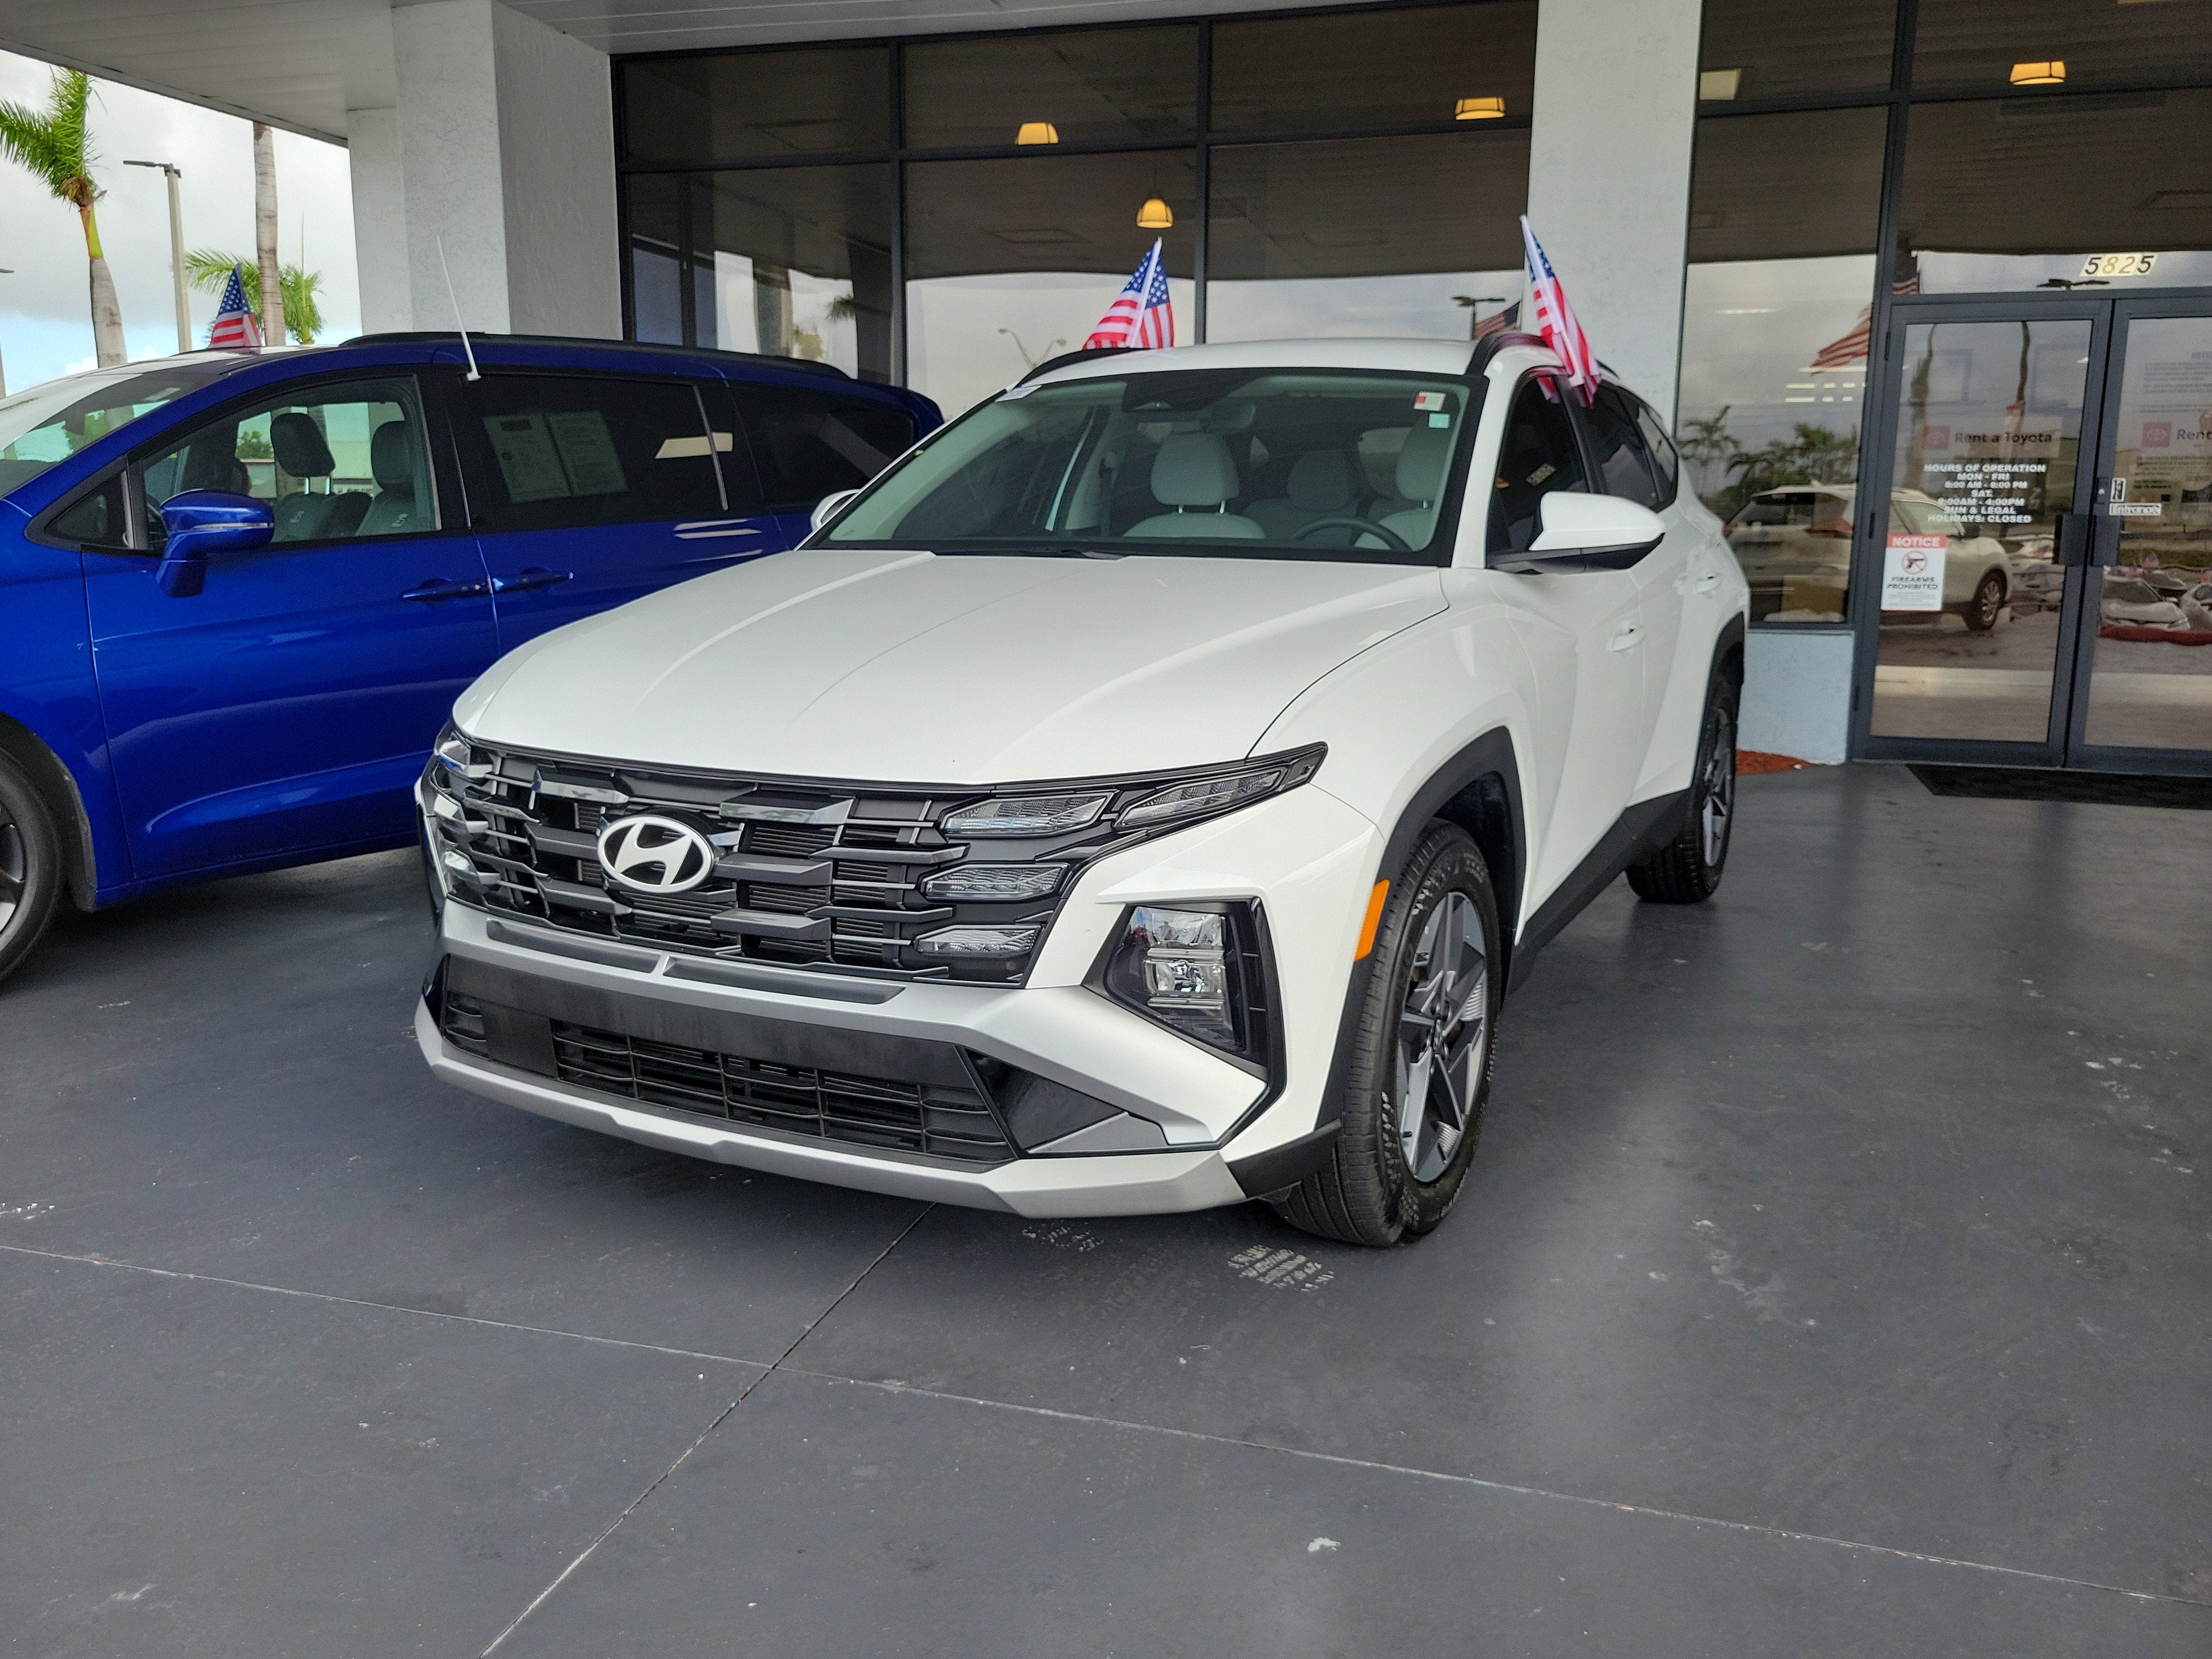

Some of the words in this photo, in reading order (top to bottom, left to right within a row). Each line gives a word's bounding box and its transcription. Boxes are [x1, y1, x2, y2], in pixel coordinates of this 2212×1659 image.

[2085, 256, 2154, 274] 5825
[2177, 428, 2212, 439] Rent
[1955, 432, 1985, 443] Rent
[2005, 432, 2052, 445] Toyota
[1924, 464, 1963, 472] HOURS
[1982, 464, 2047, 472] OPERATION
[2012, 481, 2028, 489] PM
[1980, 506, 2017, 515] LEGAL
[1987, 515, 2032, 523] CLOSED
[1892, 537, 1940, 547] NOTICE
